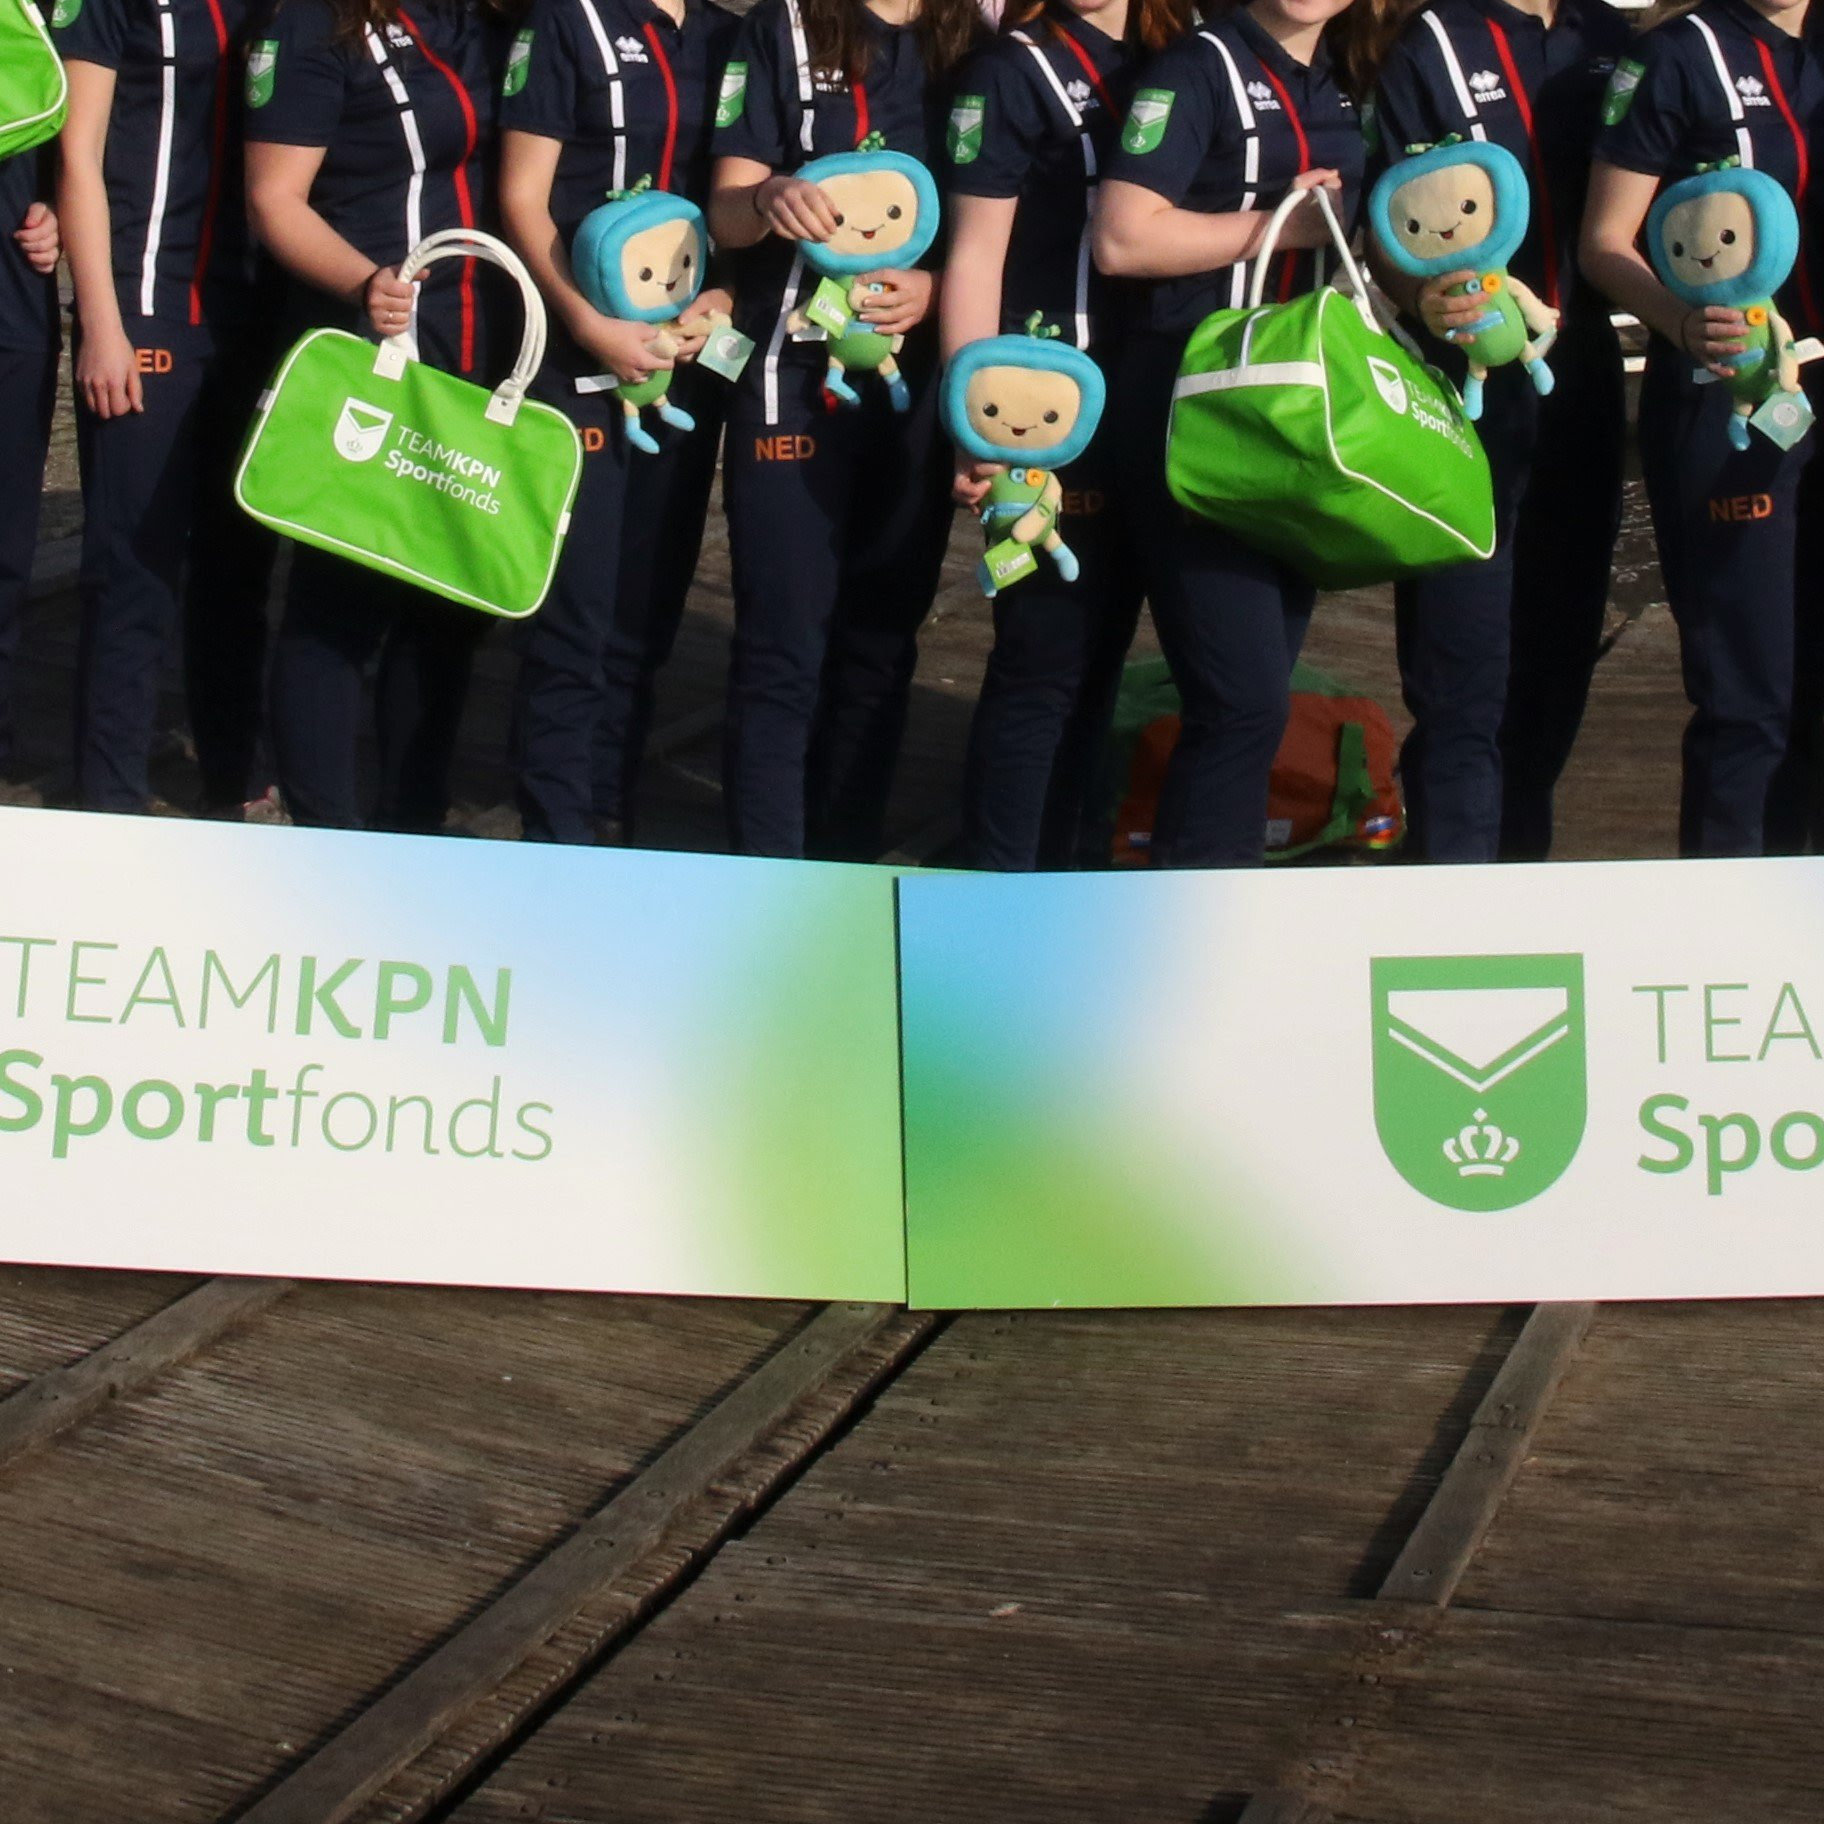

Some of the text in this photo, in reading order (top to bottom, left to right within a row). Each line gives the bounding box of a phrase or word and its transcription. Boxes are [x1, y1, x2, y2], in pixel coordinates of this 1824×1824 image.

[135, 348, 174, 374] ED
[398, 425, 502, 488] TEAMKPN
[755, 435, 817, 462] NED
[384, 449, 501, 516] Sportfonds
[1063, 489, 1105, 515] ED
[1709, 493, 1774, 523] NED
